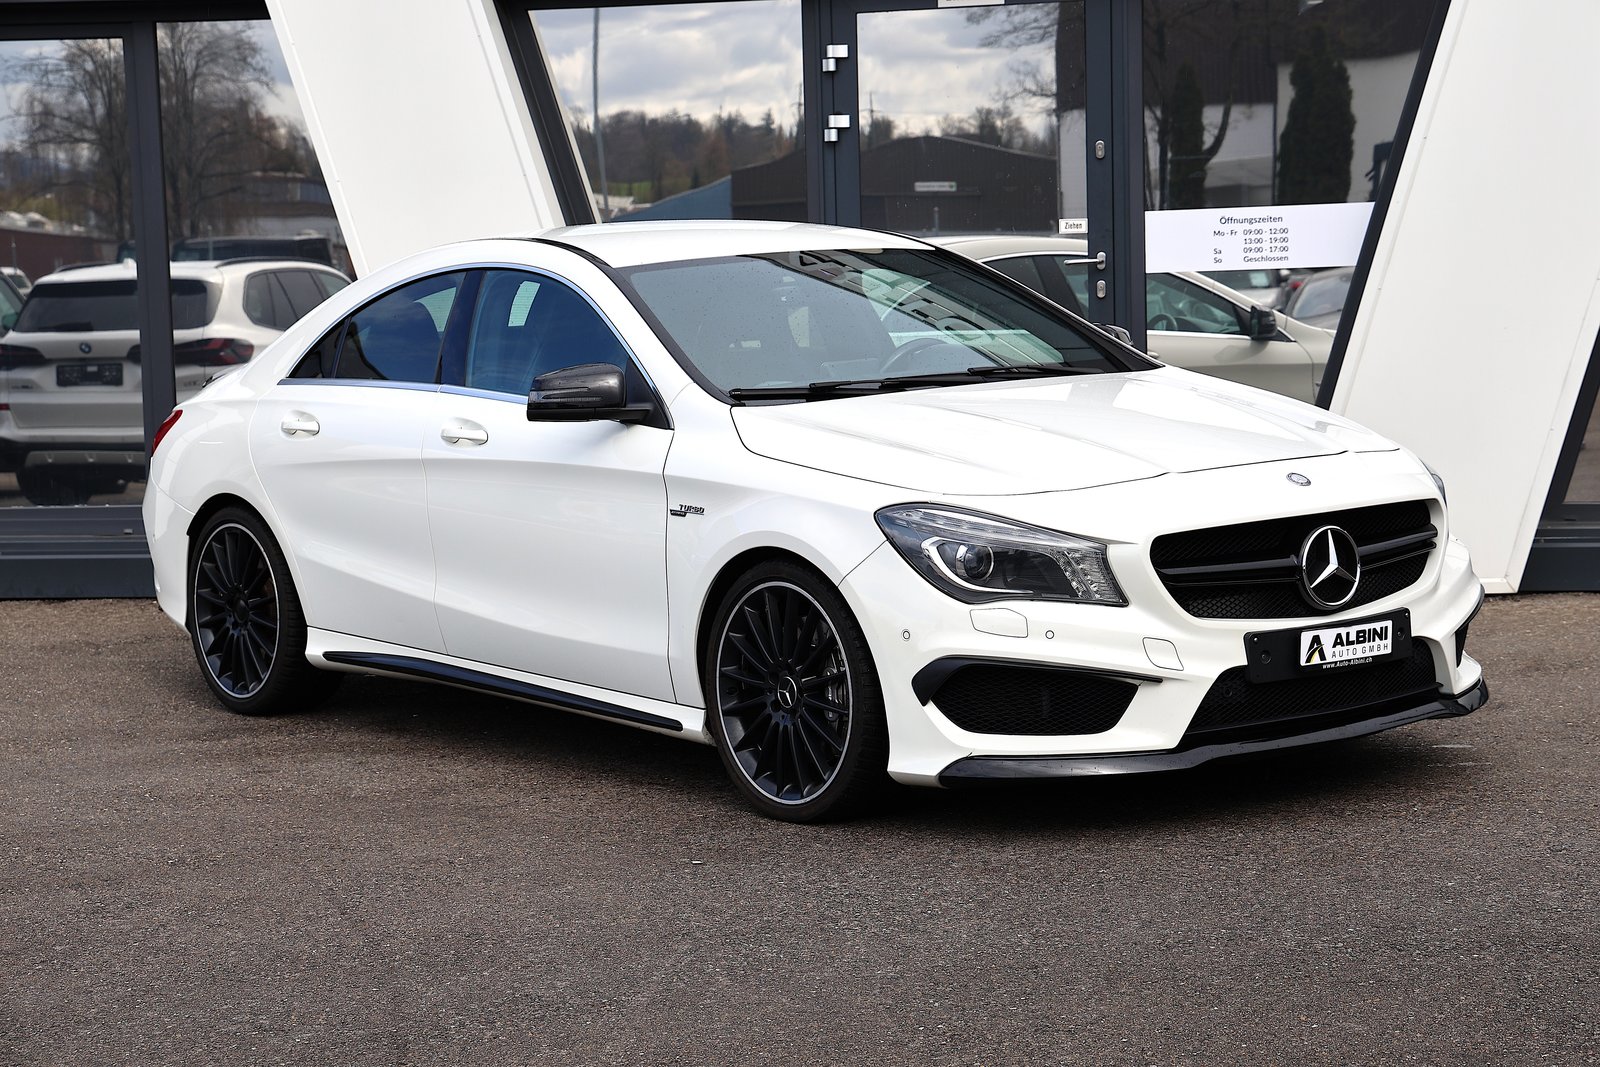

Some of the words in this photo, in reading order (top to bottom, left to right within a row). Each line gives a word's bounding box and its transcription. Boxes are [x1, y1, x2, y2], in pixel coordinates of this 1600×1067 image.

[1220, 215, 1283, 225] Öffnungszeiten
[679, 504, 705, 514] TURBO
[1332, 626, 1388, 648] ALBINI
[1331, 648, 1358, 659] AUTO
[1362, 643, 1388, 654] GMBH
[1322, 656, 1373, 670] www.Auto-Albini.ch
